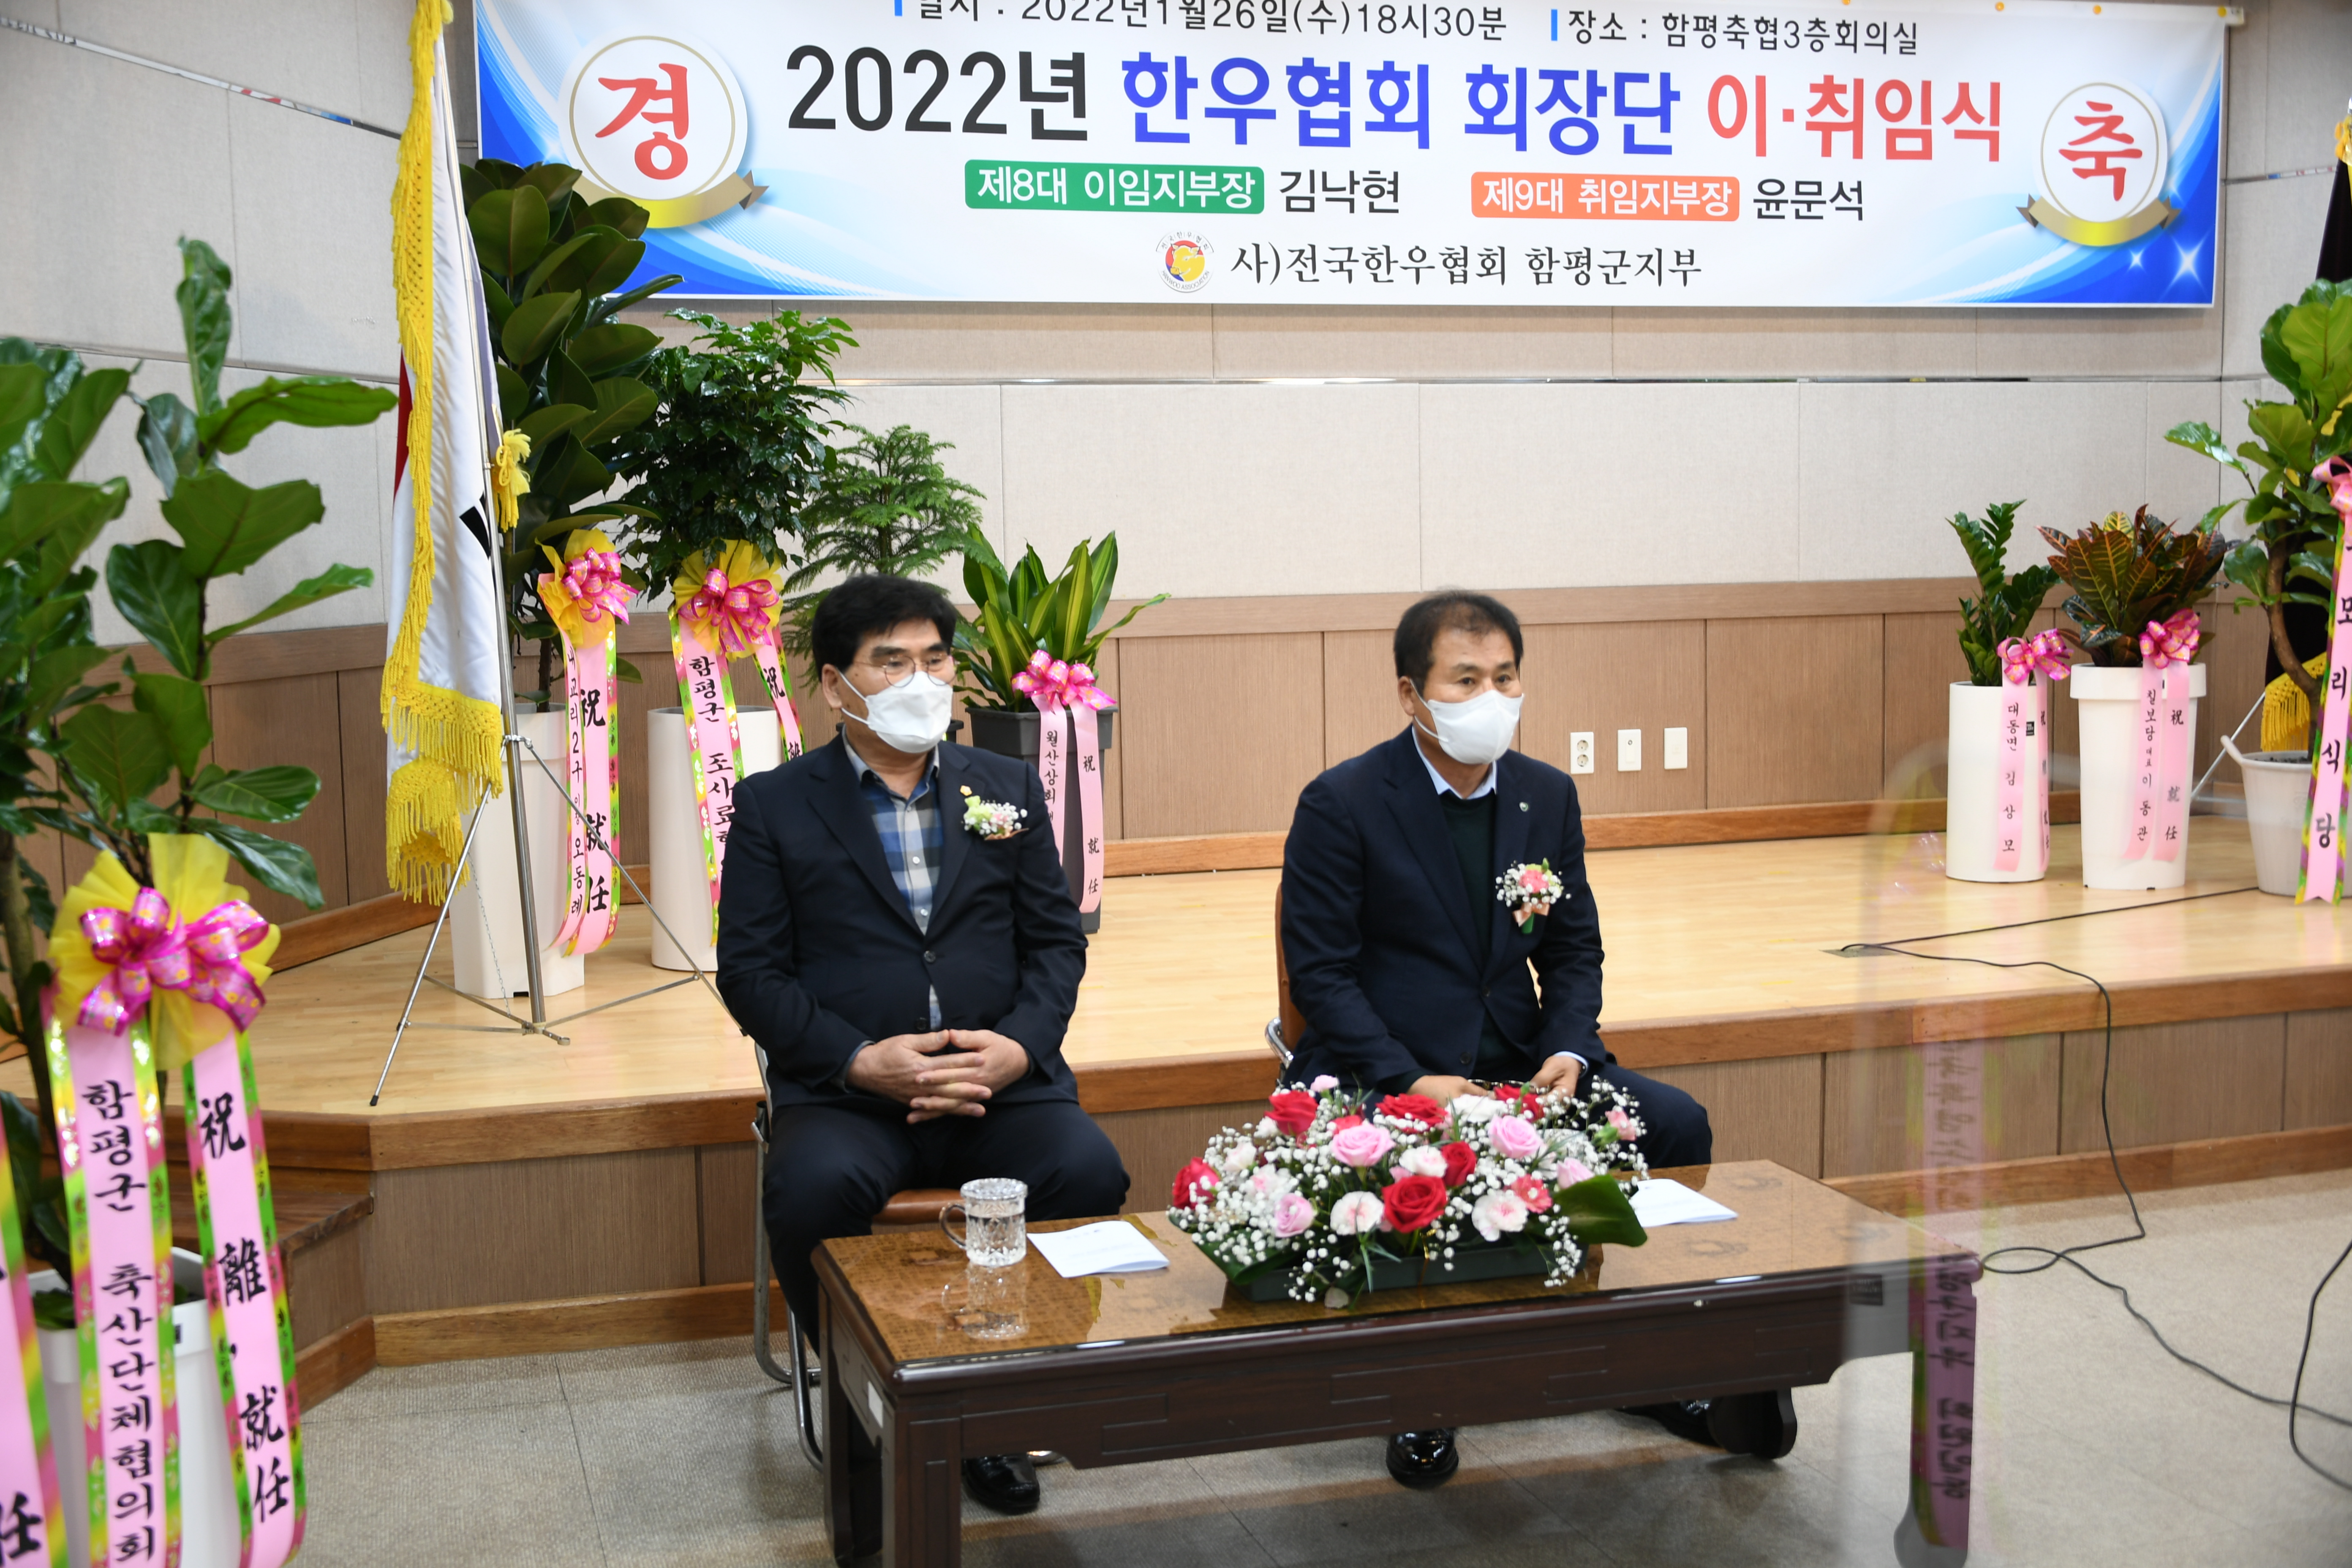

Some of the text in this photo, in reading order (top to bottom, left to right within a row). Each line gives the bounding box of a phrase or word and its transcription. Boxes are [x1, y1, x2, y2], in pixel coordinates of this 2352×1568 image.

[1568, 10, 1627, 44] 장소
[1662, 13, 1917, 55] 함평축협3층회의실
[595, 63, 689, 181] 경
[787, 45, 2001, 162] 2022년 한우협회 회장단 이·취임식
[2058, 99, 2143, 202] 축
[977, 166, 1399, 214] 제8대 이임지부장 김낙현
[1483, 179, 1863, 221] 제9대 취임지부장 윤문석
[1231, 242, 1701, 287] 사)전국한우협회 함평군지부
[689, 656, 725, 723] 함평군
[763, 666, 785, 700] 祝
[580, 689, 606, 728] 祝
[2006, 702, 2020, 751] 대동면
[2145, 689, 2157, 741] 칠보당
[2170, 709, 2184, 726] 祝
[1044, 730, 1059, 805] 월산상회
[1083, 754, 1096, 772] 祝
[2145, 747, 2153, 767] 대표
[571, 838, 585, 918] 오동례
[199, 1092, 246, 1160] 祝
[82, 1080, 154, 1564] 함평군 축산단체협의회
